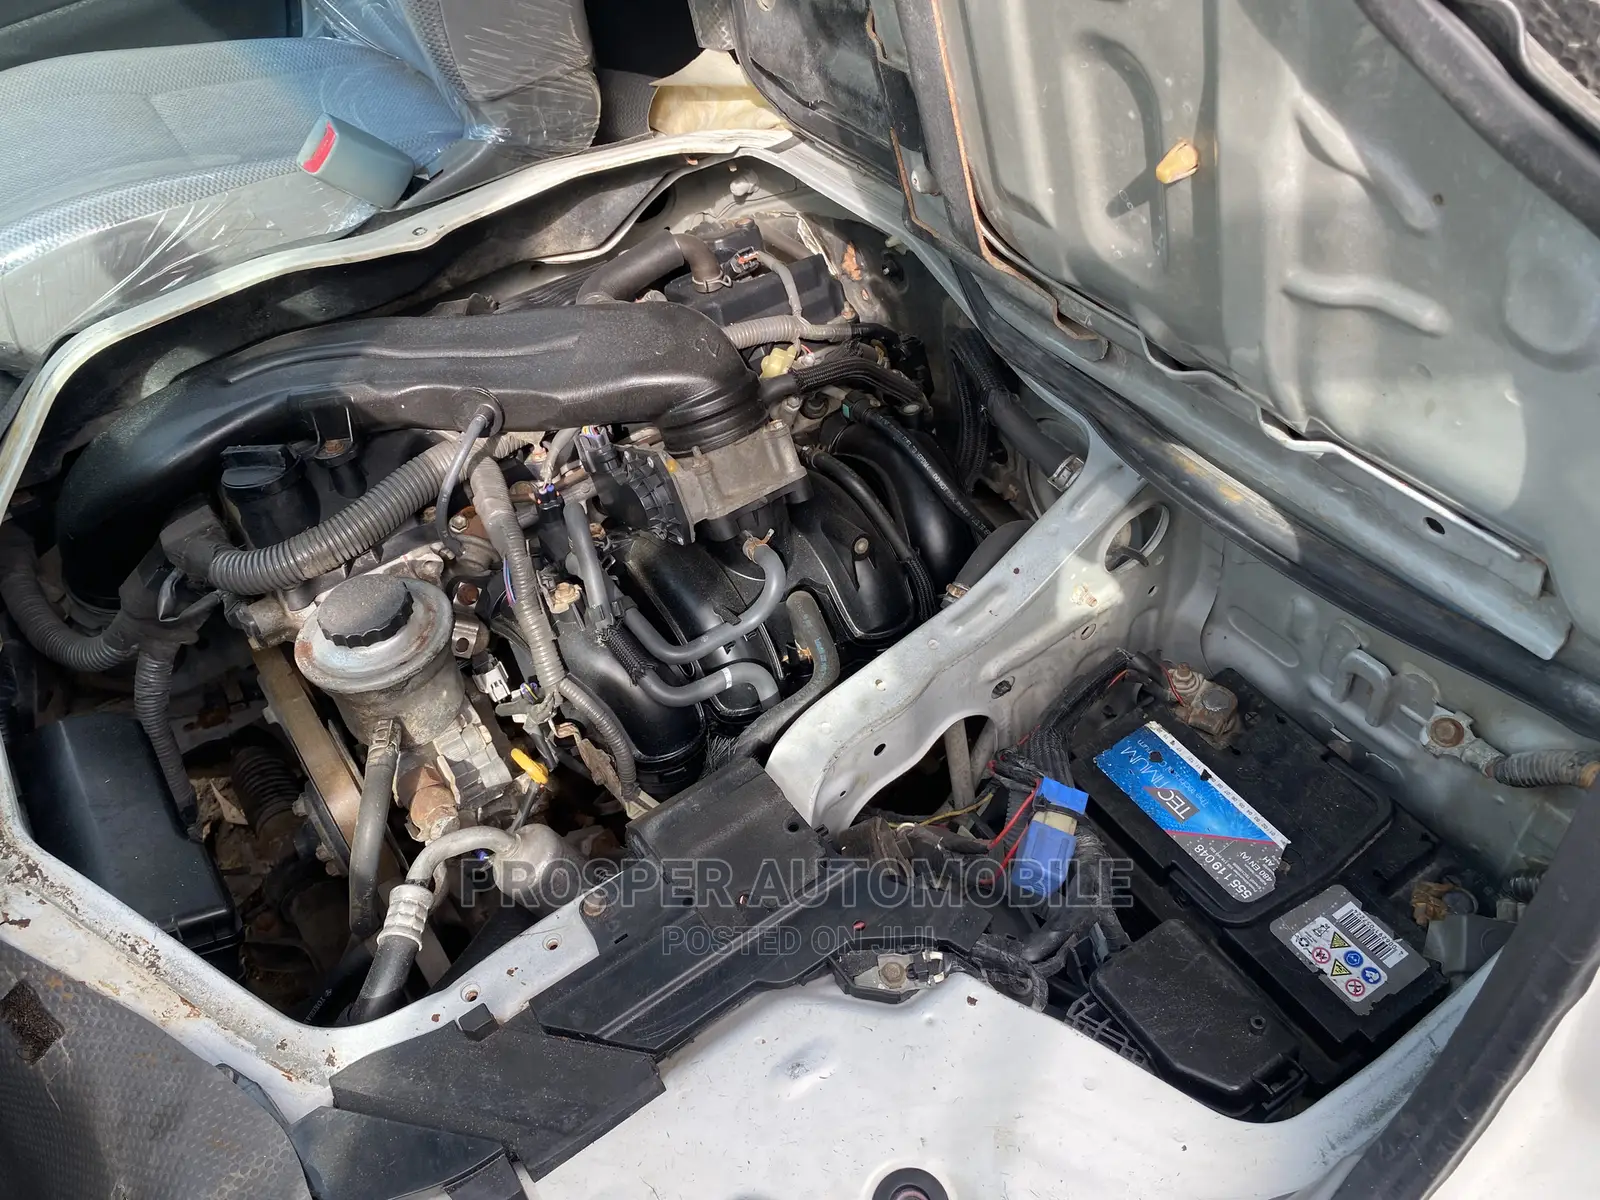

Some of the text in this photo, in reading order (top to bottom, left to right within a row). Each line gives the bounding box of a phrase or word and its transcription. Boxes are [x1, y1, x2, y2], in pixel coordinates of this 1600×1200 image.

[1193, 843, 1215, 863] 048
[1239, 850, 1251, 861] (A)
[1248, 860, 1260, 870] EN
[1262, 856, 1275, 866] AH
[1258, 869, 1273, 882] 480
[1229, 878, 1253, 899] 555
